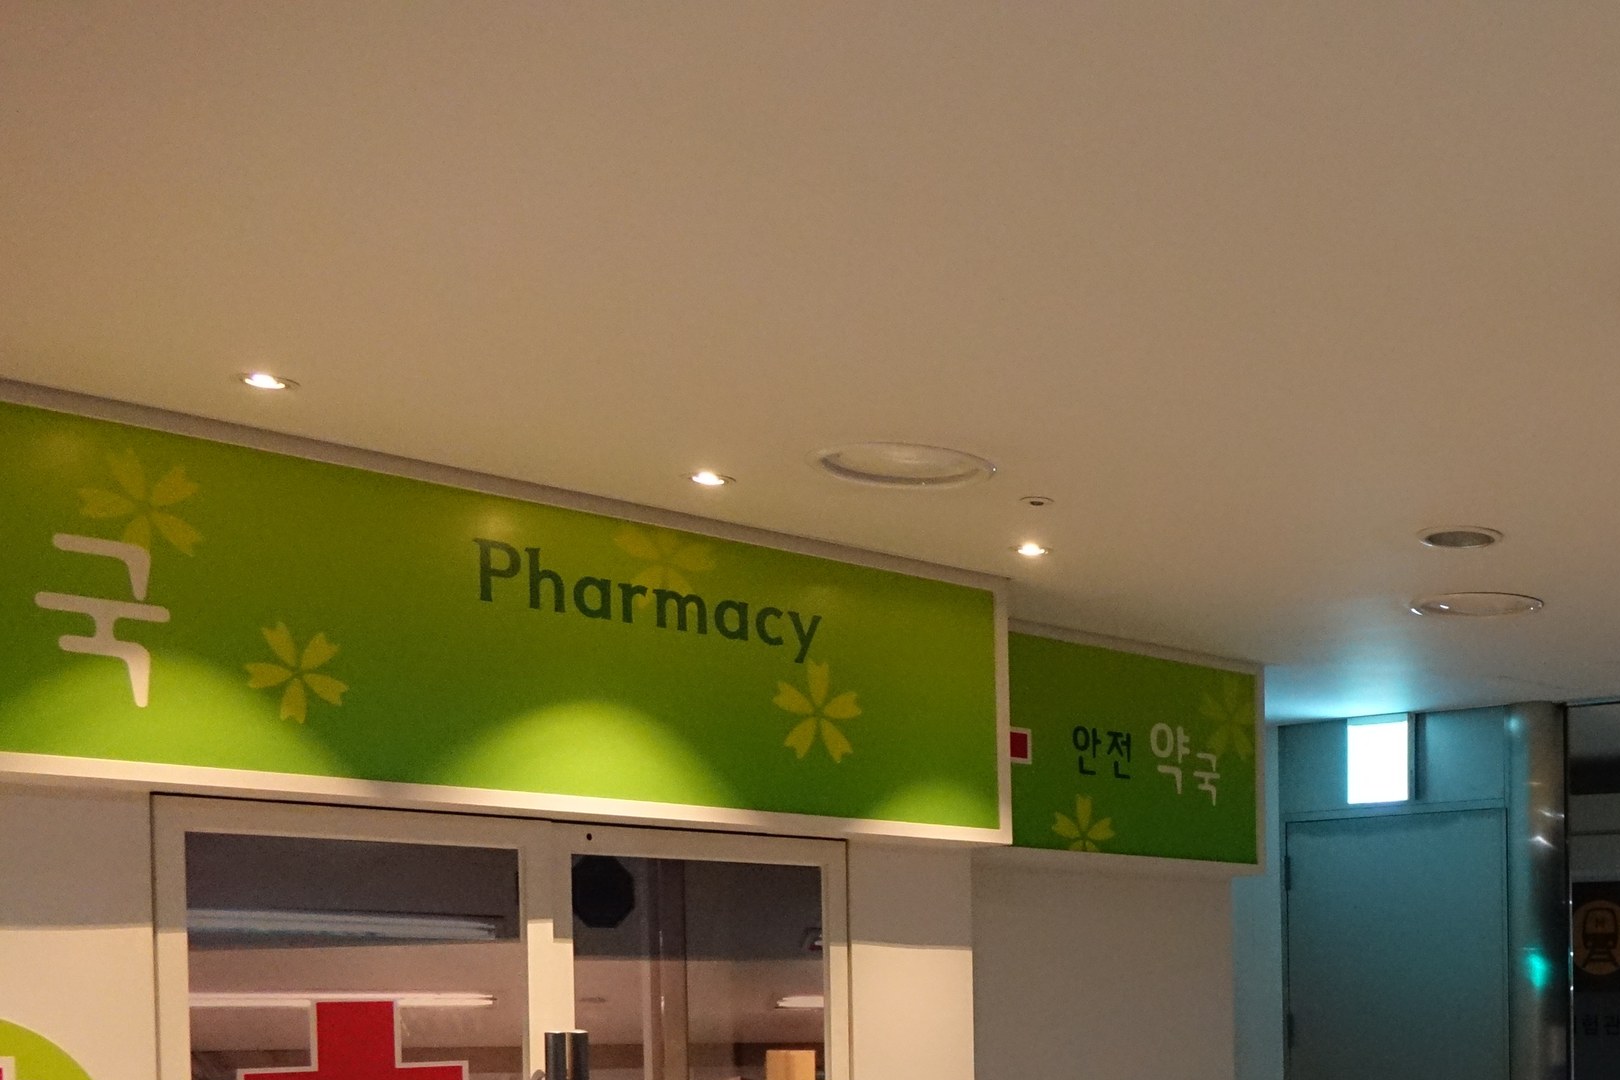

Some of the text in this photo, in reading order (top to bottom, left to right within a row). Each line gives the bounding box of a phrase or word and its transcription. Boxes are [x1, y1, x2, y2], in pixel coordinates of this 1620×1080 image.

[34, 532, 171, 708] 국
[473, 537, 822, 664] Pharmacy
[1072, 722, 1221, 807] 안전 약국
